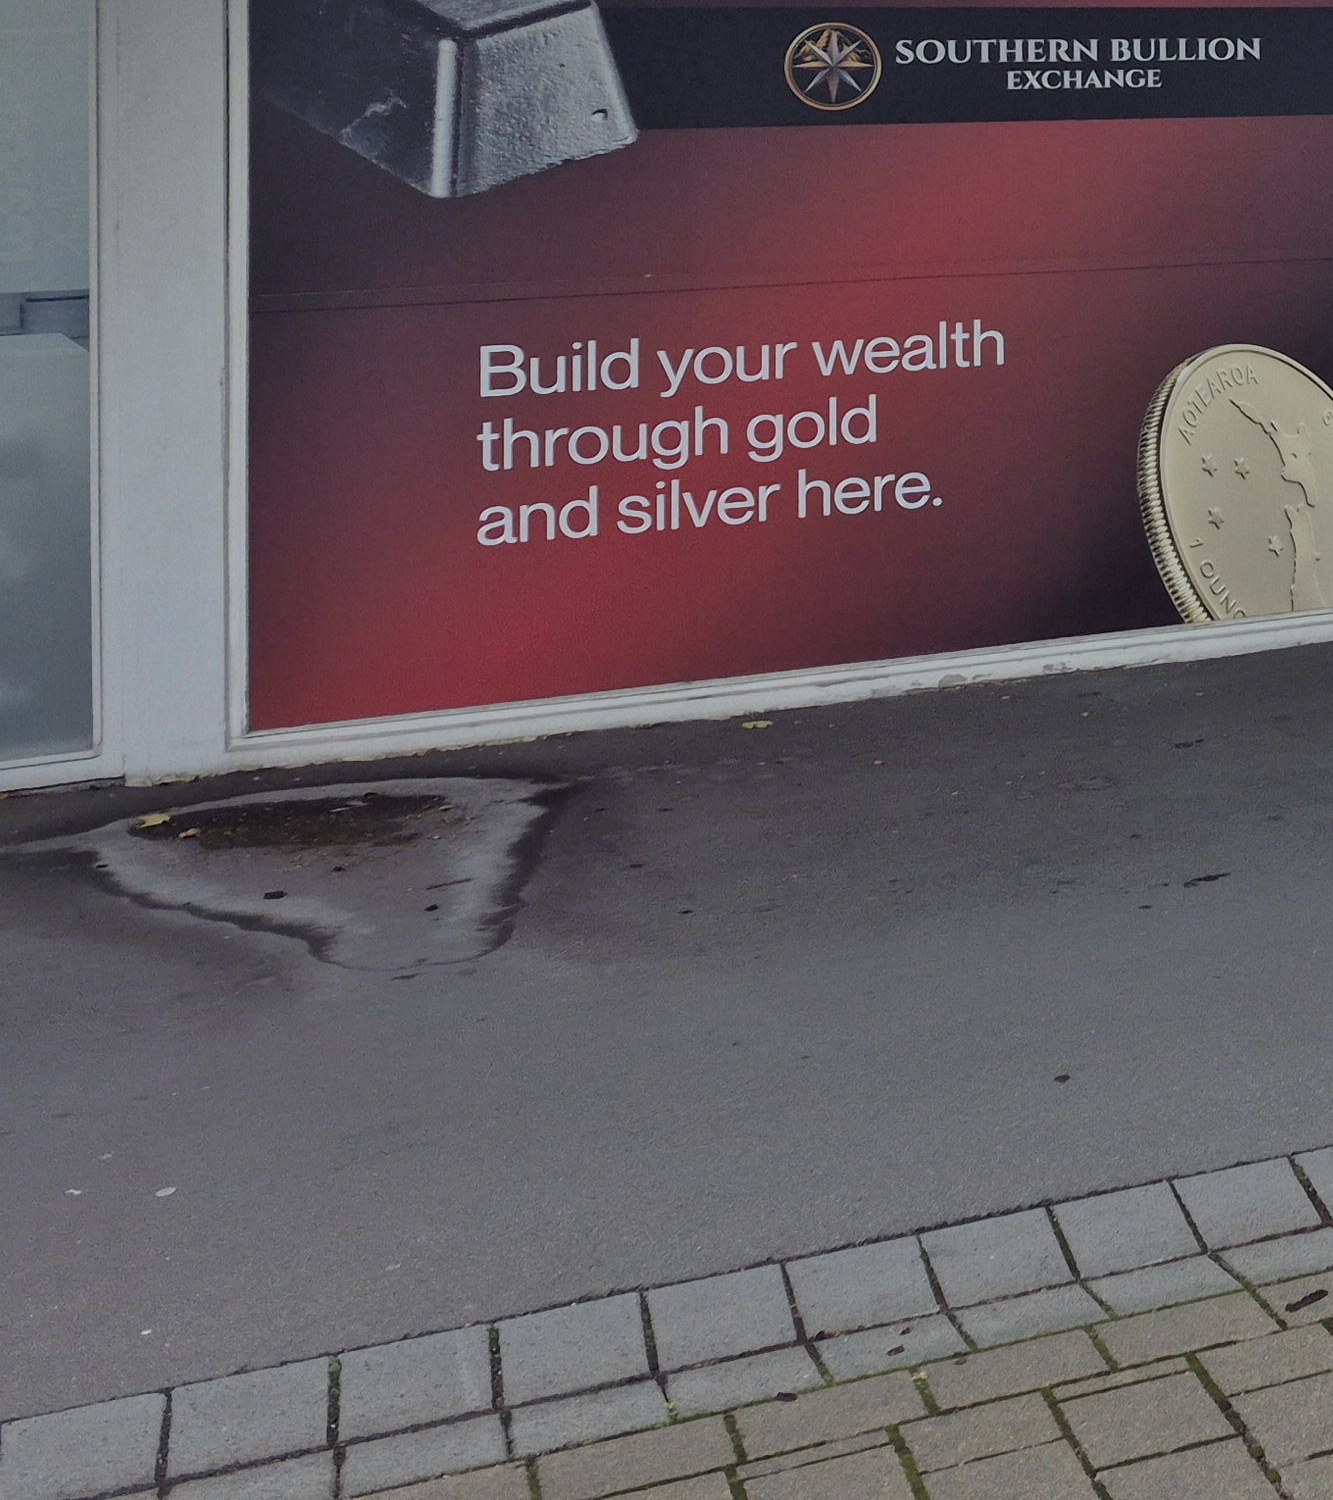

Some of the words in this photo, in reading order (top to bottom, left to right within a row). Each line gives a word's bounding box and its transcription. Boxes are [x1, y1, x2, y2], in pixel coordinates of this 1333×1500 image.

[895, 38, 1099, 66] SOUTHERN
[1110, 37, 1262, 62] BULLION
[1006, 68, 1163, 91] EXCHANGE
[478, 337, 640, 397] Build
[656, 342, 798, 400] your
[810, 319, 1006, 378] wealth
[476, 405, 730, 473] through
[745, 393, 878, 463] gold
[1177, 362, 1259, 446] AOTEAROA
[476, 484, 598, 547] and
[616, 478, 779, 534] silver
[795, 468, 944, 520] here.
